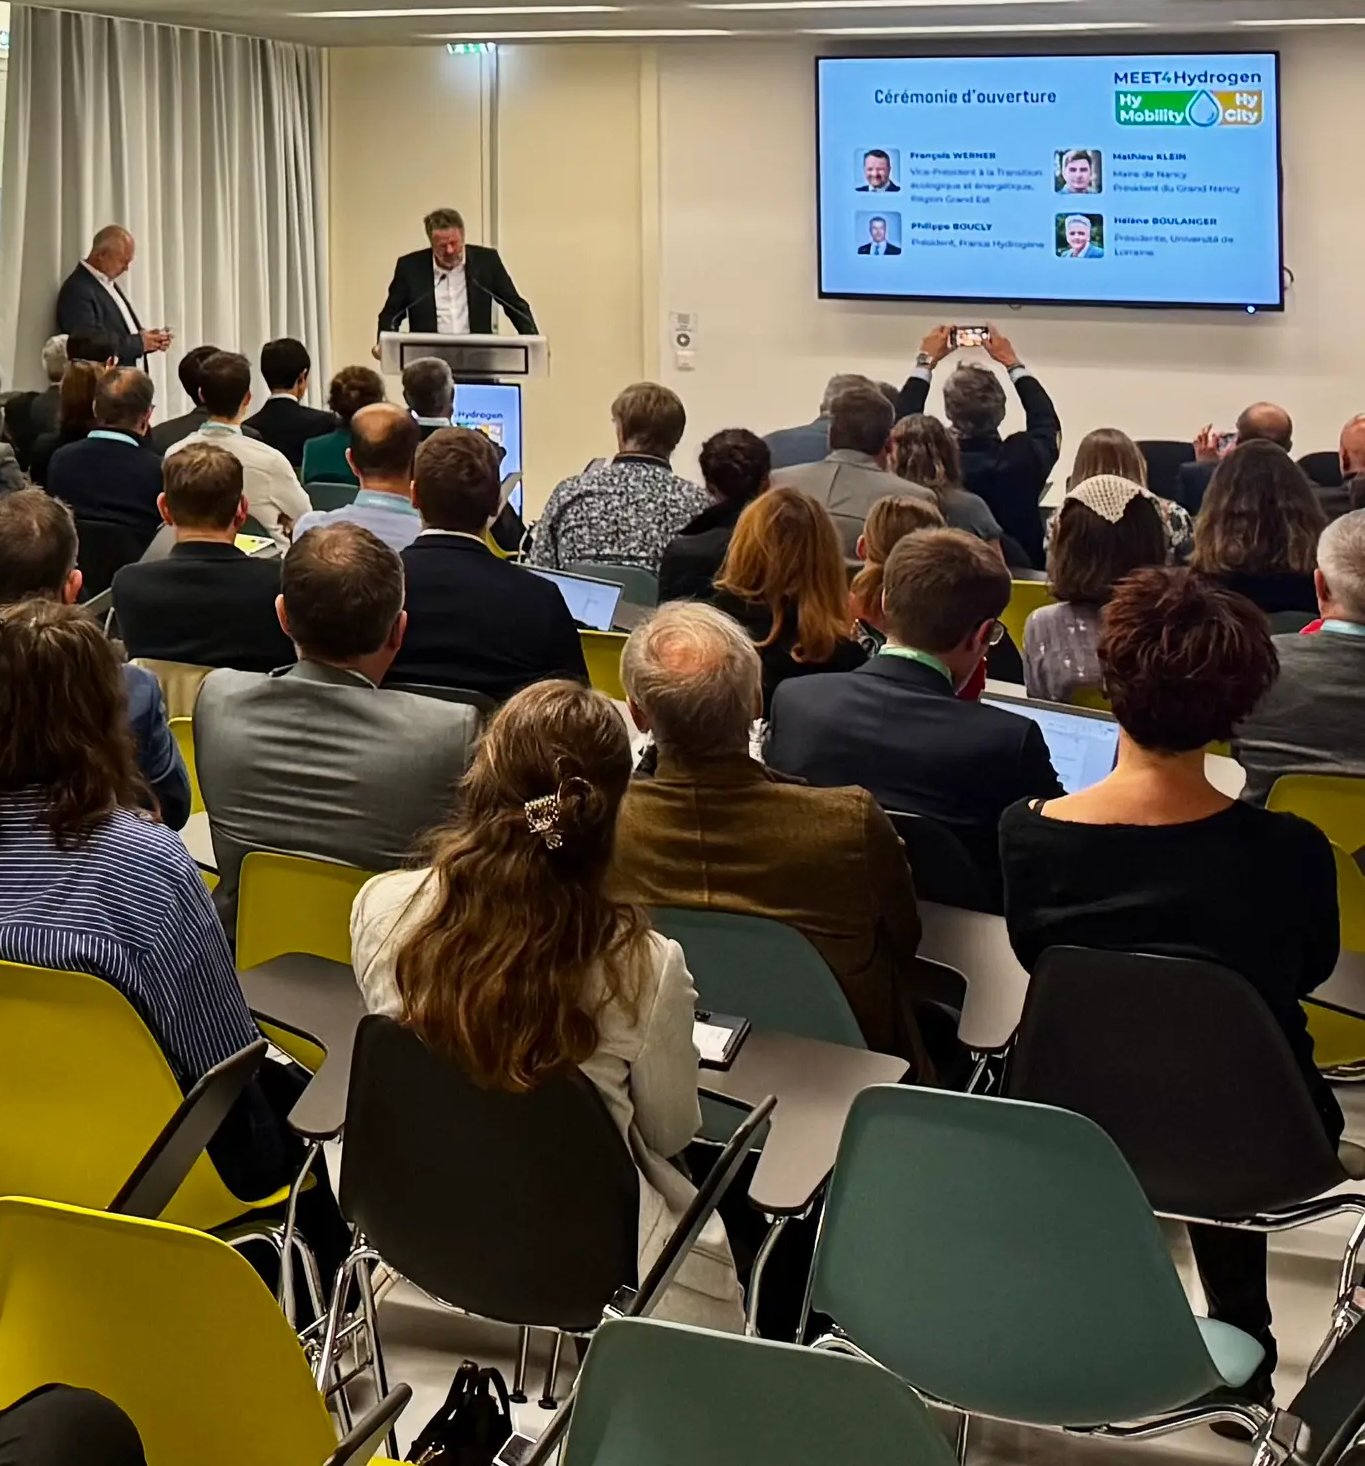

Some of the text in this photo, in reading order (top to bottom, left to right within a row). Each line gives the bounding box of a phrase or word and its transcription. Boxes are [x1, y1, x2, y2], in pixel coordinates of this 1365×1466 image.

[1114, 70, 1262, 86] MEET4Hydrogen
[874, 88, 1057, 104] Cérémonie d'ouverture
[1119, 93, 1142, 109] Hy
[1235, 93, 1258, 108] Hy
[1119, 108, 1185, 124] Mobility
[1224, 108, 1258, 124] City
[952, 222, 993, 231] BOUCLY
[1151, 216, 1218, 226] BOULANGER
[454, 410, 503, 421] Hydrogen
